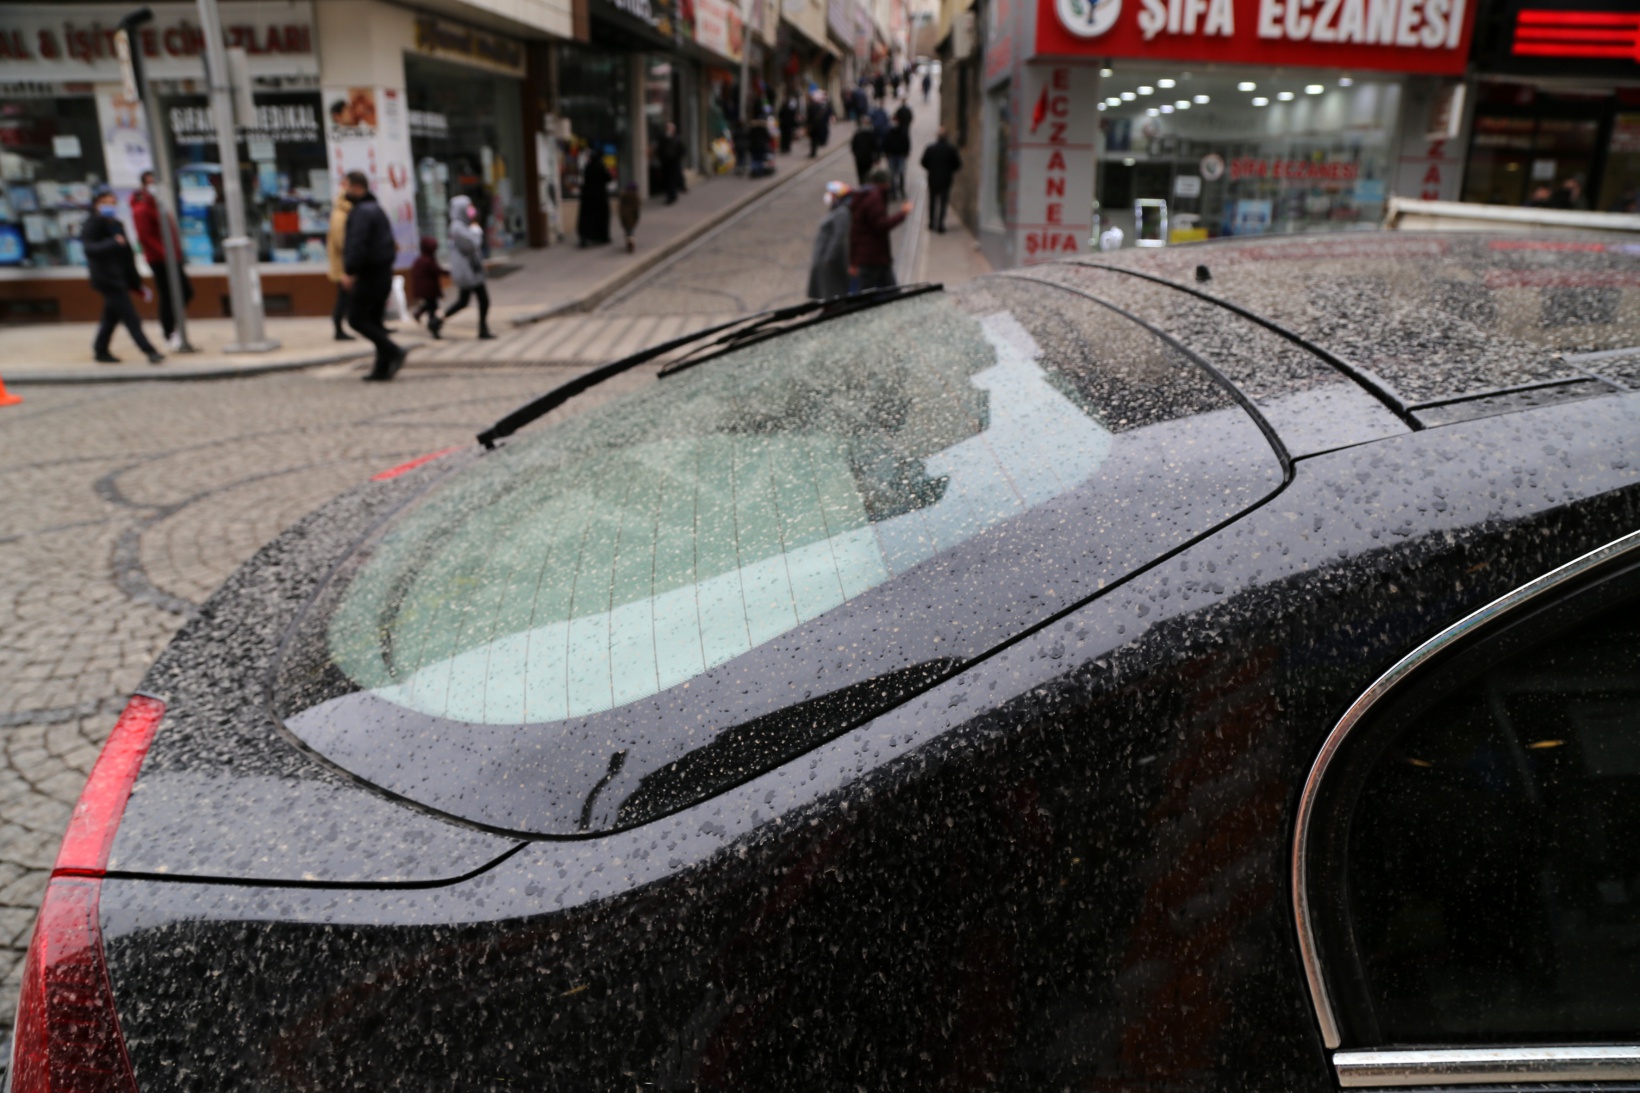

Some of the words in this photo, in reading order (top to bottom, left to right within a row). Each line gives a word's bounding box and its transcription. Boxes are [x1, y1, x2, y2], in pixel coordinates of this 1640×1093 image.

[37, 29, 56, 59] &
[63, 20, 157, 65] İŞİTE
[1045, 68, 1071, 225] ECZANE
[1025, 227, 1079, 255] ŞİFA
